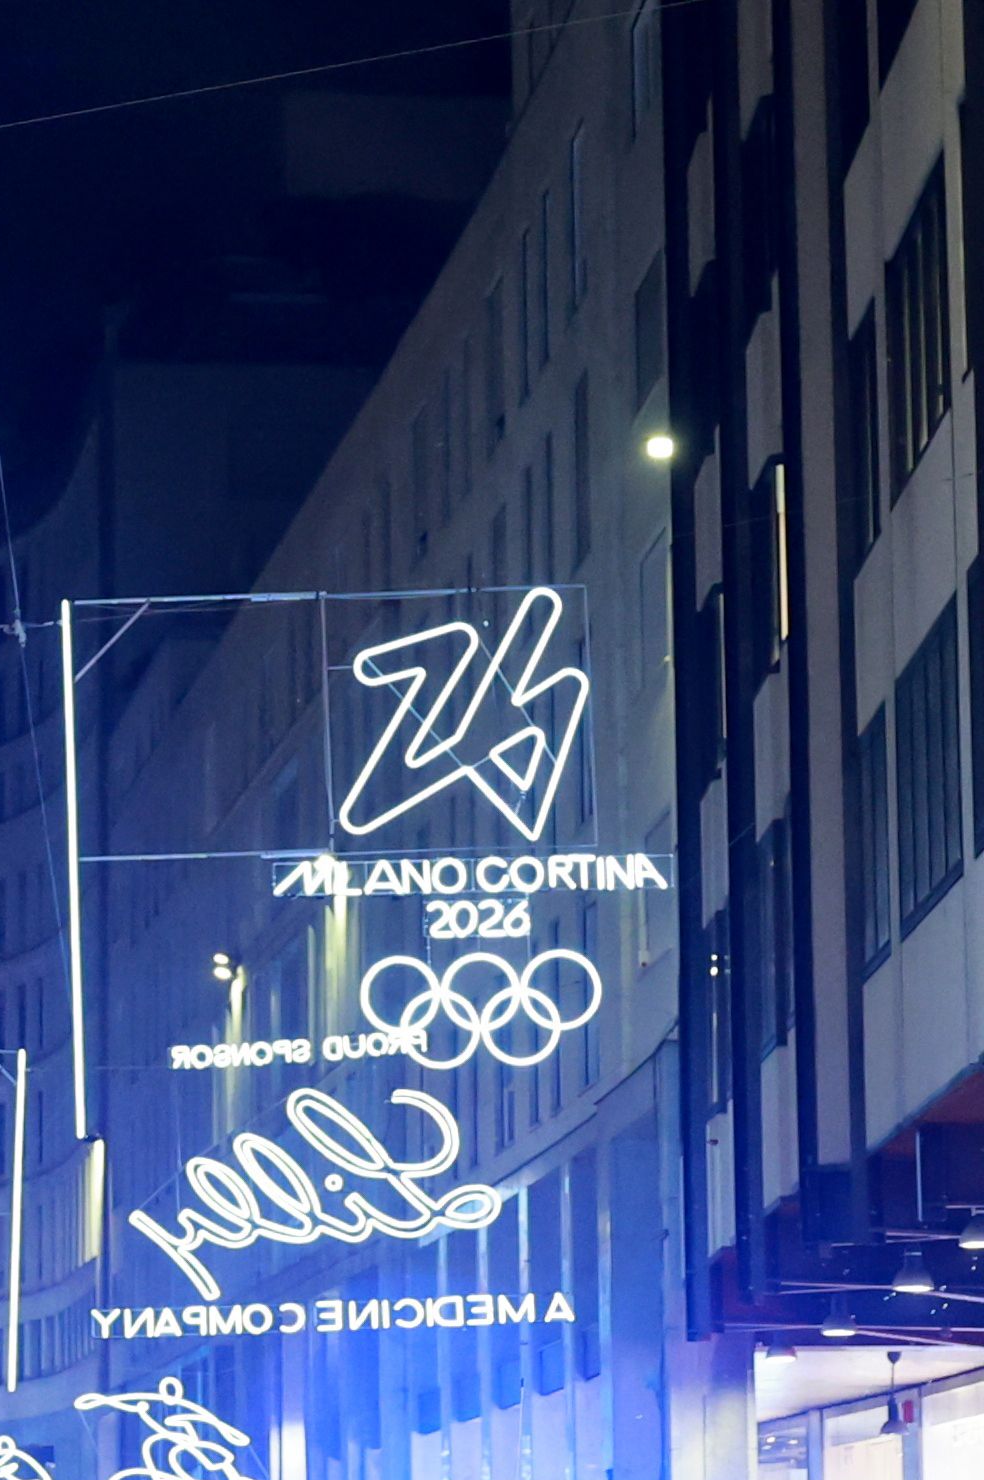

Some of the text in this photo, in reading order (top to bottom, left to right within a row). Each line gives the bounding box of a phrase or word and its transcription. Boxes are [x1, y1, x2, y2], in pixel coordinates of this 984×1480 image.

[273, 853, 668, 897] MILANO CORTINA
[426, 899, 531, 939] 2026
